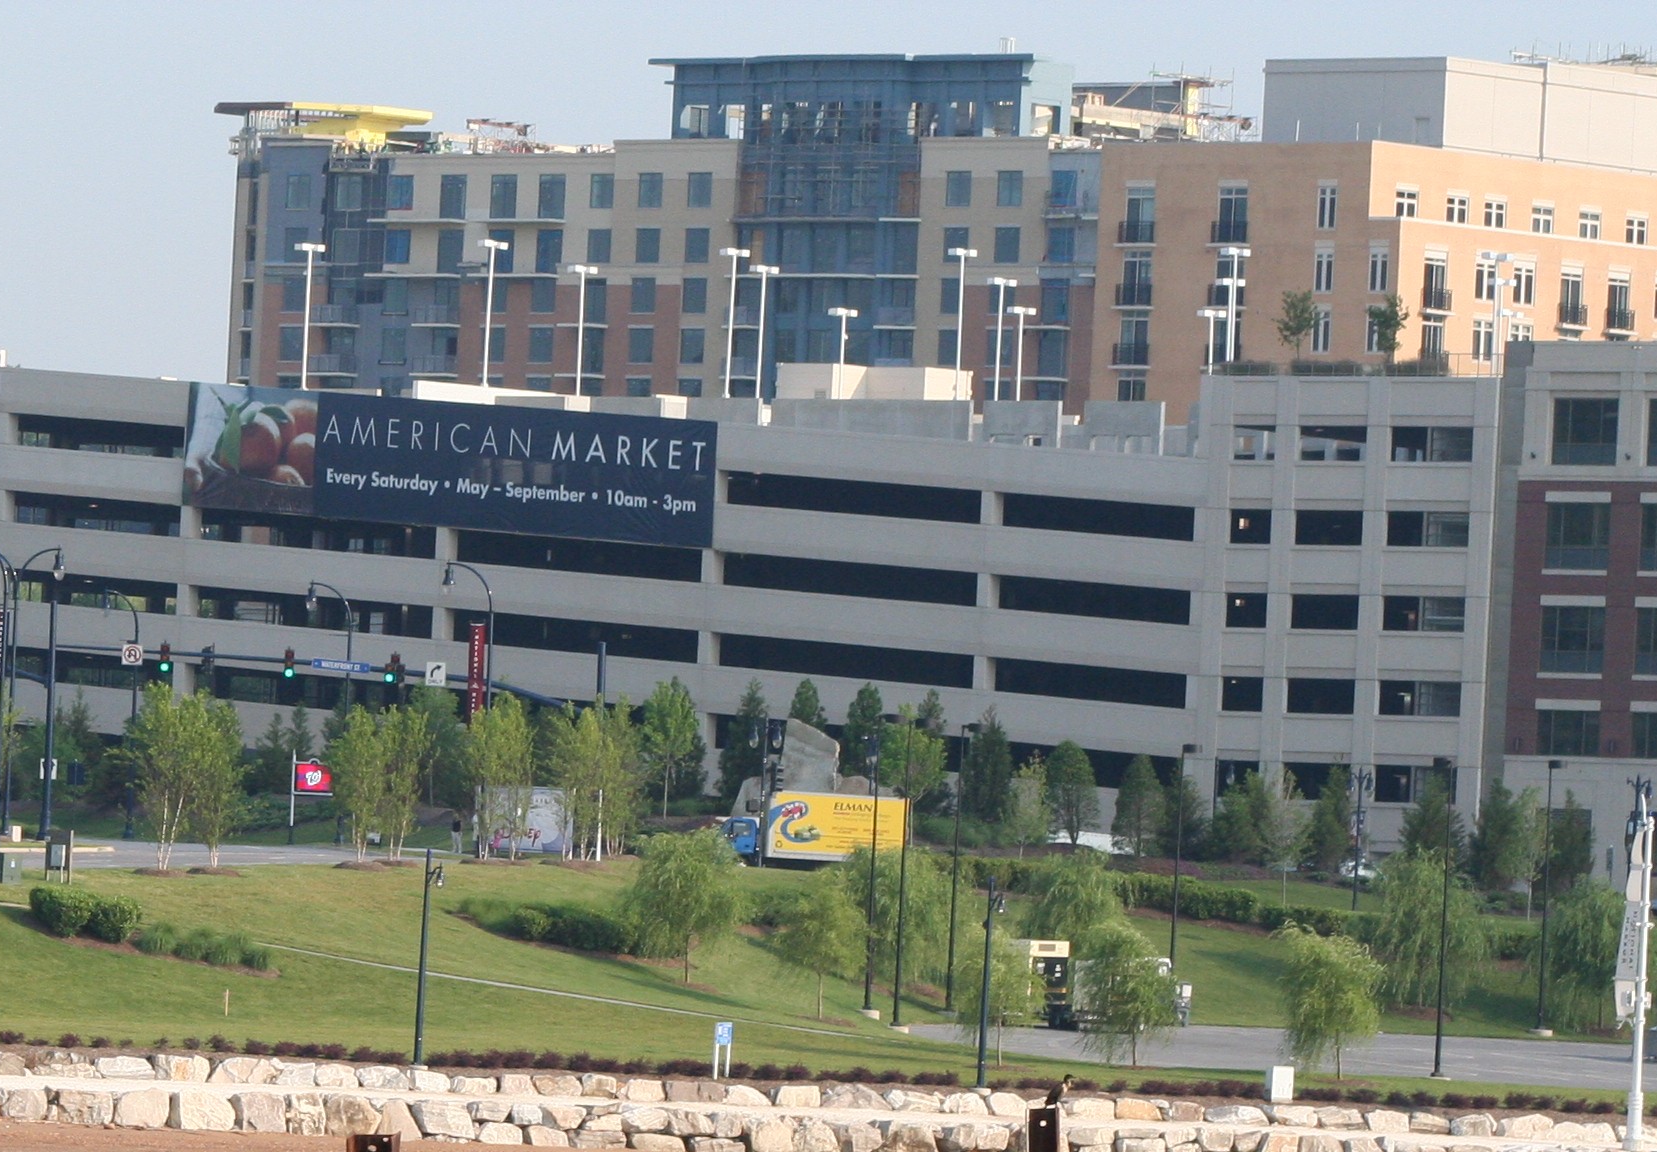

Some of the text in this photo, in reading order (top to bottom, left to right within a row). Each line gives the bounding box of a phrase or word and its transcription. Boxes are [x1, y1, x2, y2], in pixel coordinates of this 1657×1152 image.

[323, 414, 706, 472] AMERICAN MARKET
[326, 468, 367, 490] Every
[371, 471, 439, 496] Saturday
[456, 477, 490, 499] May
[505, 481, 586, 503] September
[606, 489, 648, 508] 10am
[662, 494, 697, 515] 3pm
[833, 802, 873, 812] ELMAN
